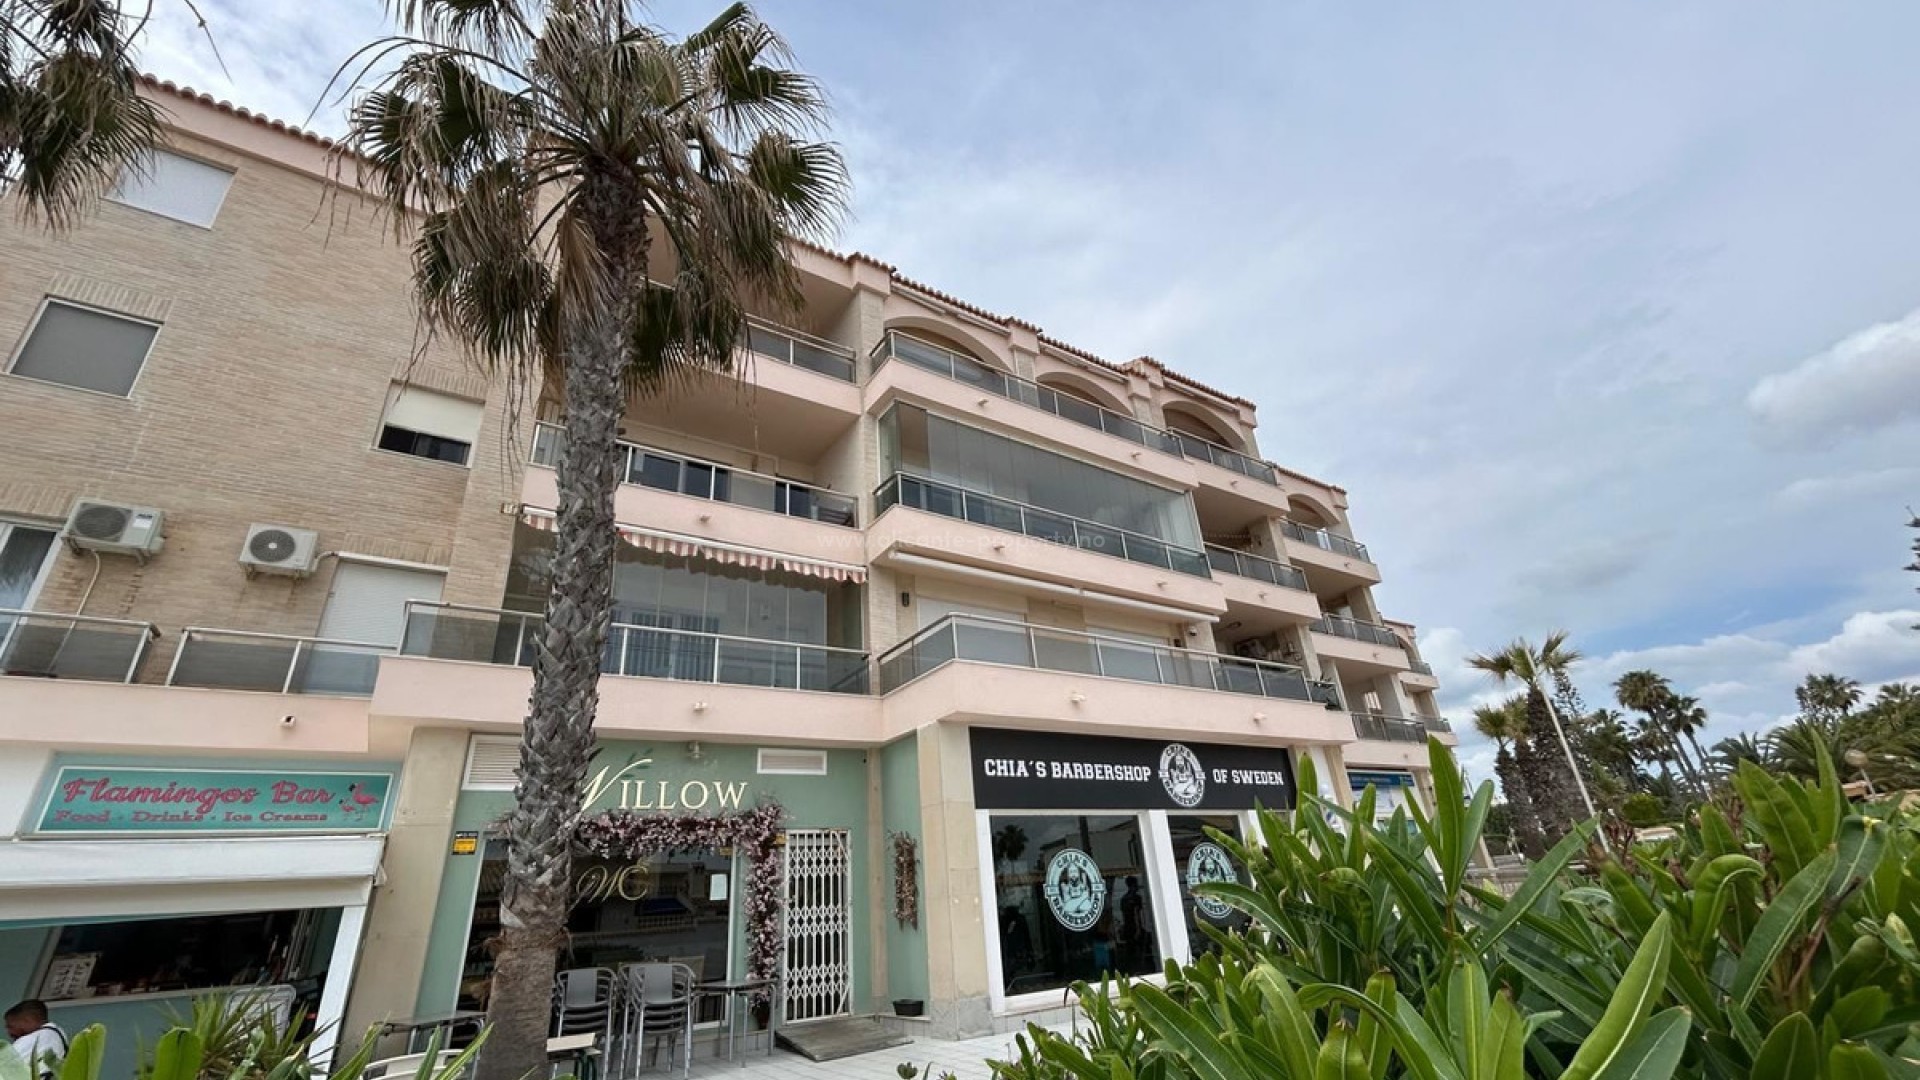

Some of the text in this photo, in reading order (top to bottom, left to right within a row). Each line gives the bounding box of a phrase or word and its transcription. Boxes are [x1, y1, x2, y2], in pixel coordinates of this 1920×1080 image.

[1050, 761, 1152, 782] BARBERSHOP
[1212, 768, 1228, 784] OF
[1231, 769, 1285, 786] SWEDEN
[63, 777, 336, 814] Flamingos Bar
[54, 810, 328, 822] Food Drinks Ice Creams
